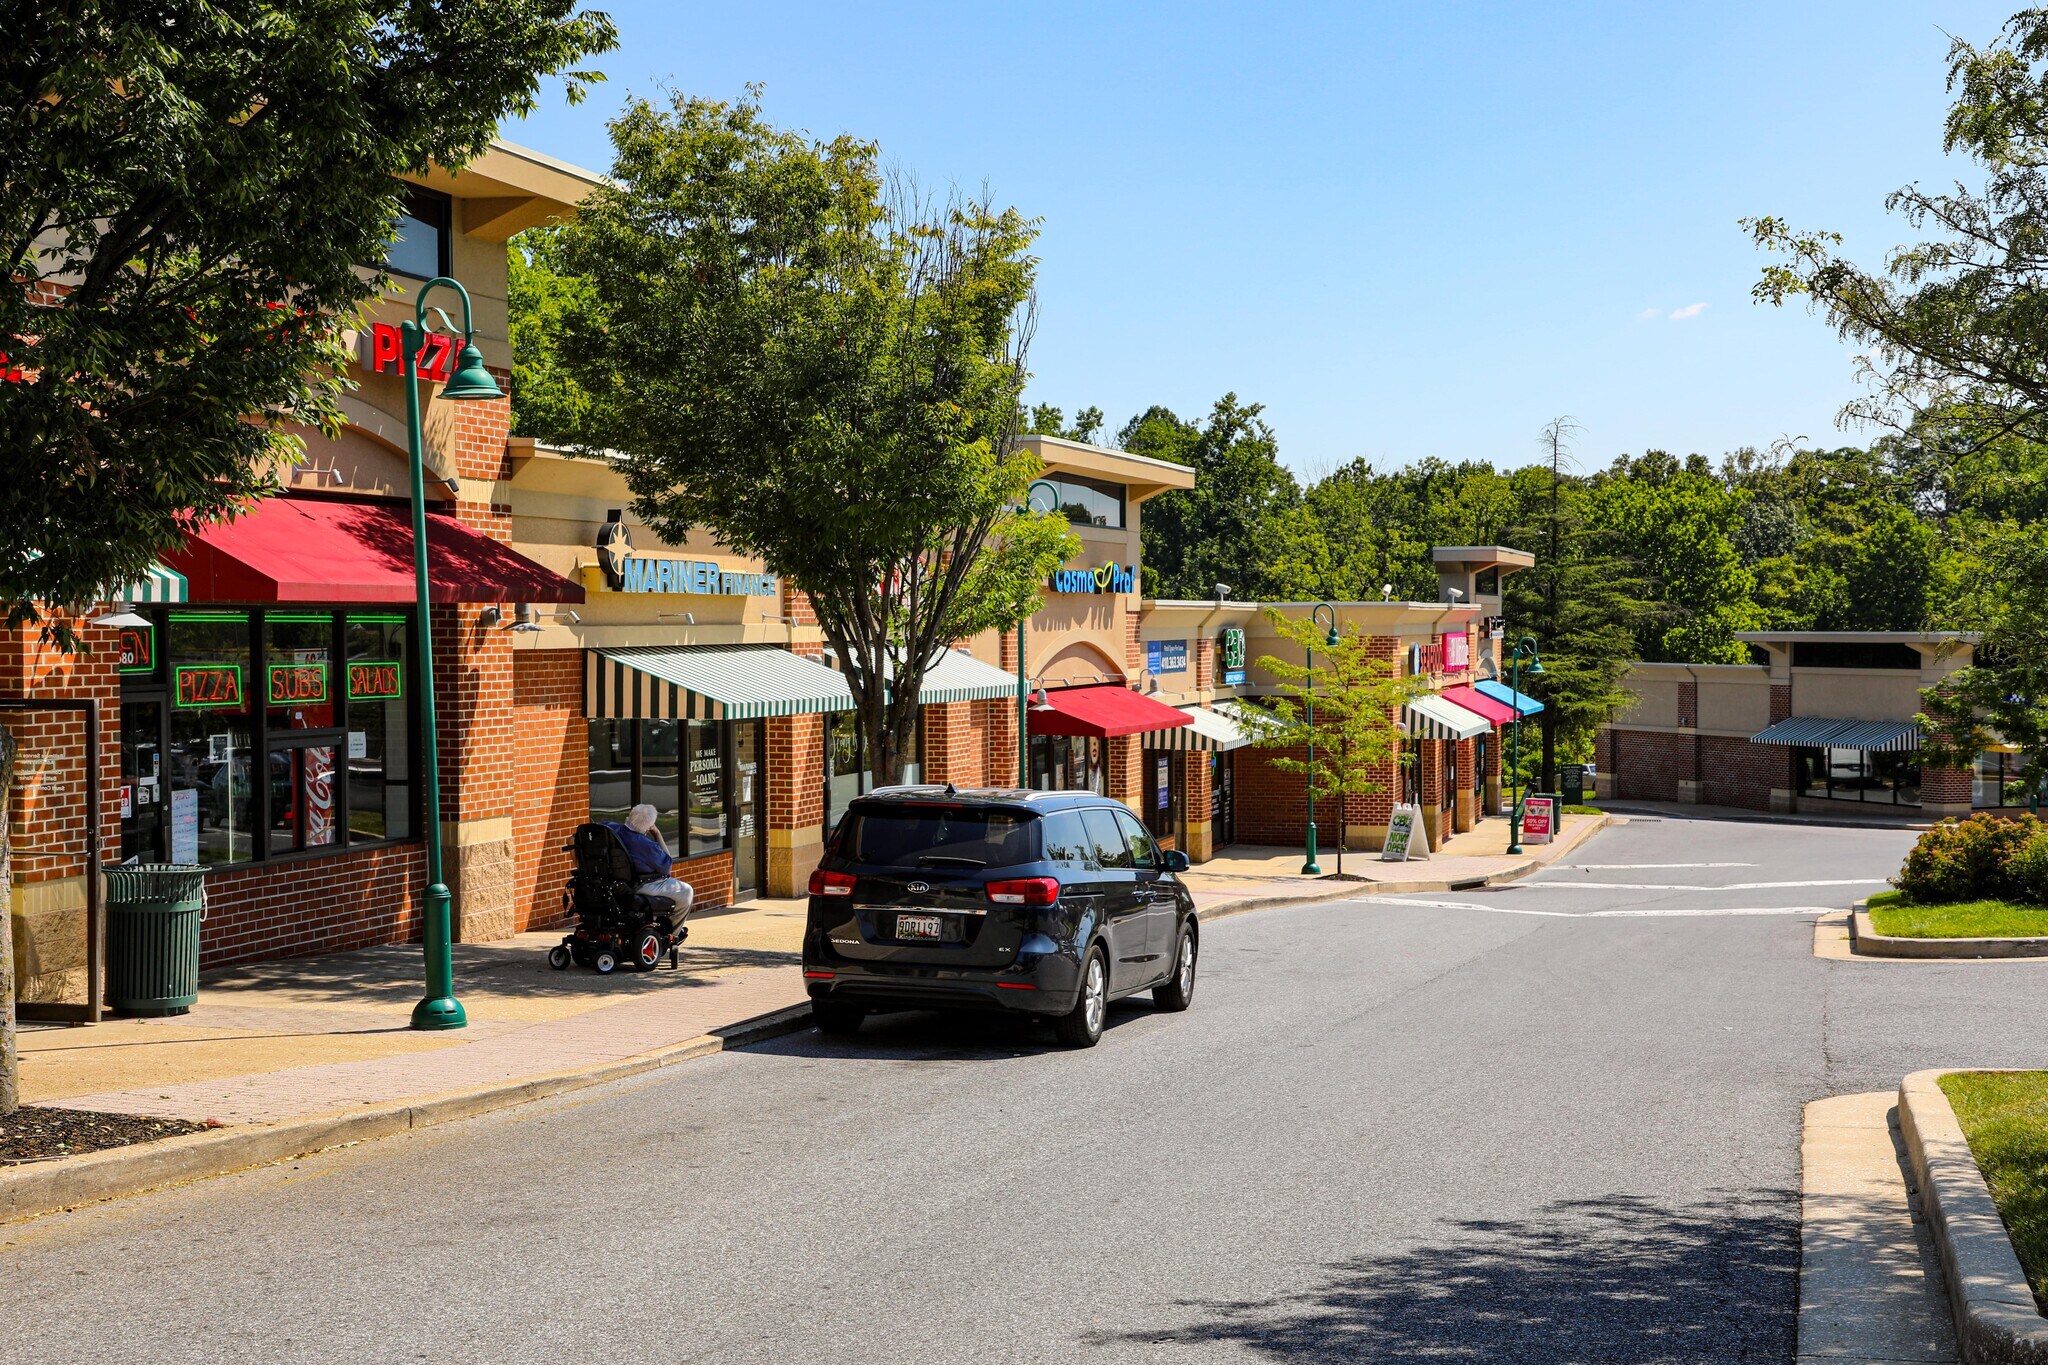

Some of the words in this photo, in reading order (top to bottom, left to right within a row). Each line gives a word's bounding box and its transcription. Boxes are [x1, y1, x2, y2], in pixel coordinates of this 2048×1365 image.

[624, 558, 720, 595] MARINER
[722, 572, 776, 596] FINANCE
[1055, 560, 1095, 593] Cosmo
[1112, 562, 1136, 593] Prof
[179, 670, 239, 702] PIZZA
[271, 669, 323, 699] SUBS
[350, 666, 398, 695] SALADS
[695, 750, 703, 758] WE
[703, 748, 716, 757] MAKE
[690, 757, 722, 773] PERSONAL
[696, 772, 716, 786] LOANS
[1389, 832, 1410, 844] NOW
[1386, 843, 1407, 854] OPEN
[909, 883, 926, 892] KIA
[830, 937, 860, 945] SEDONA
